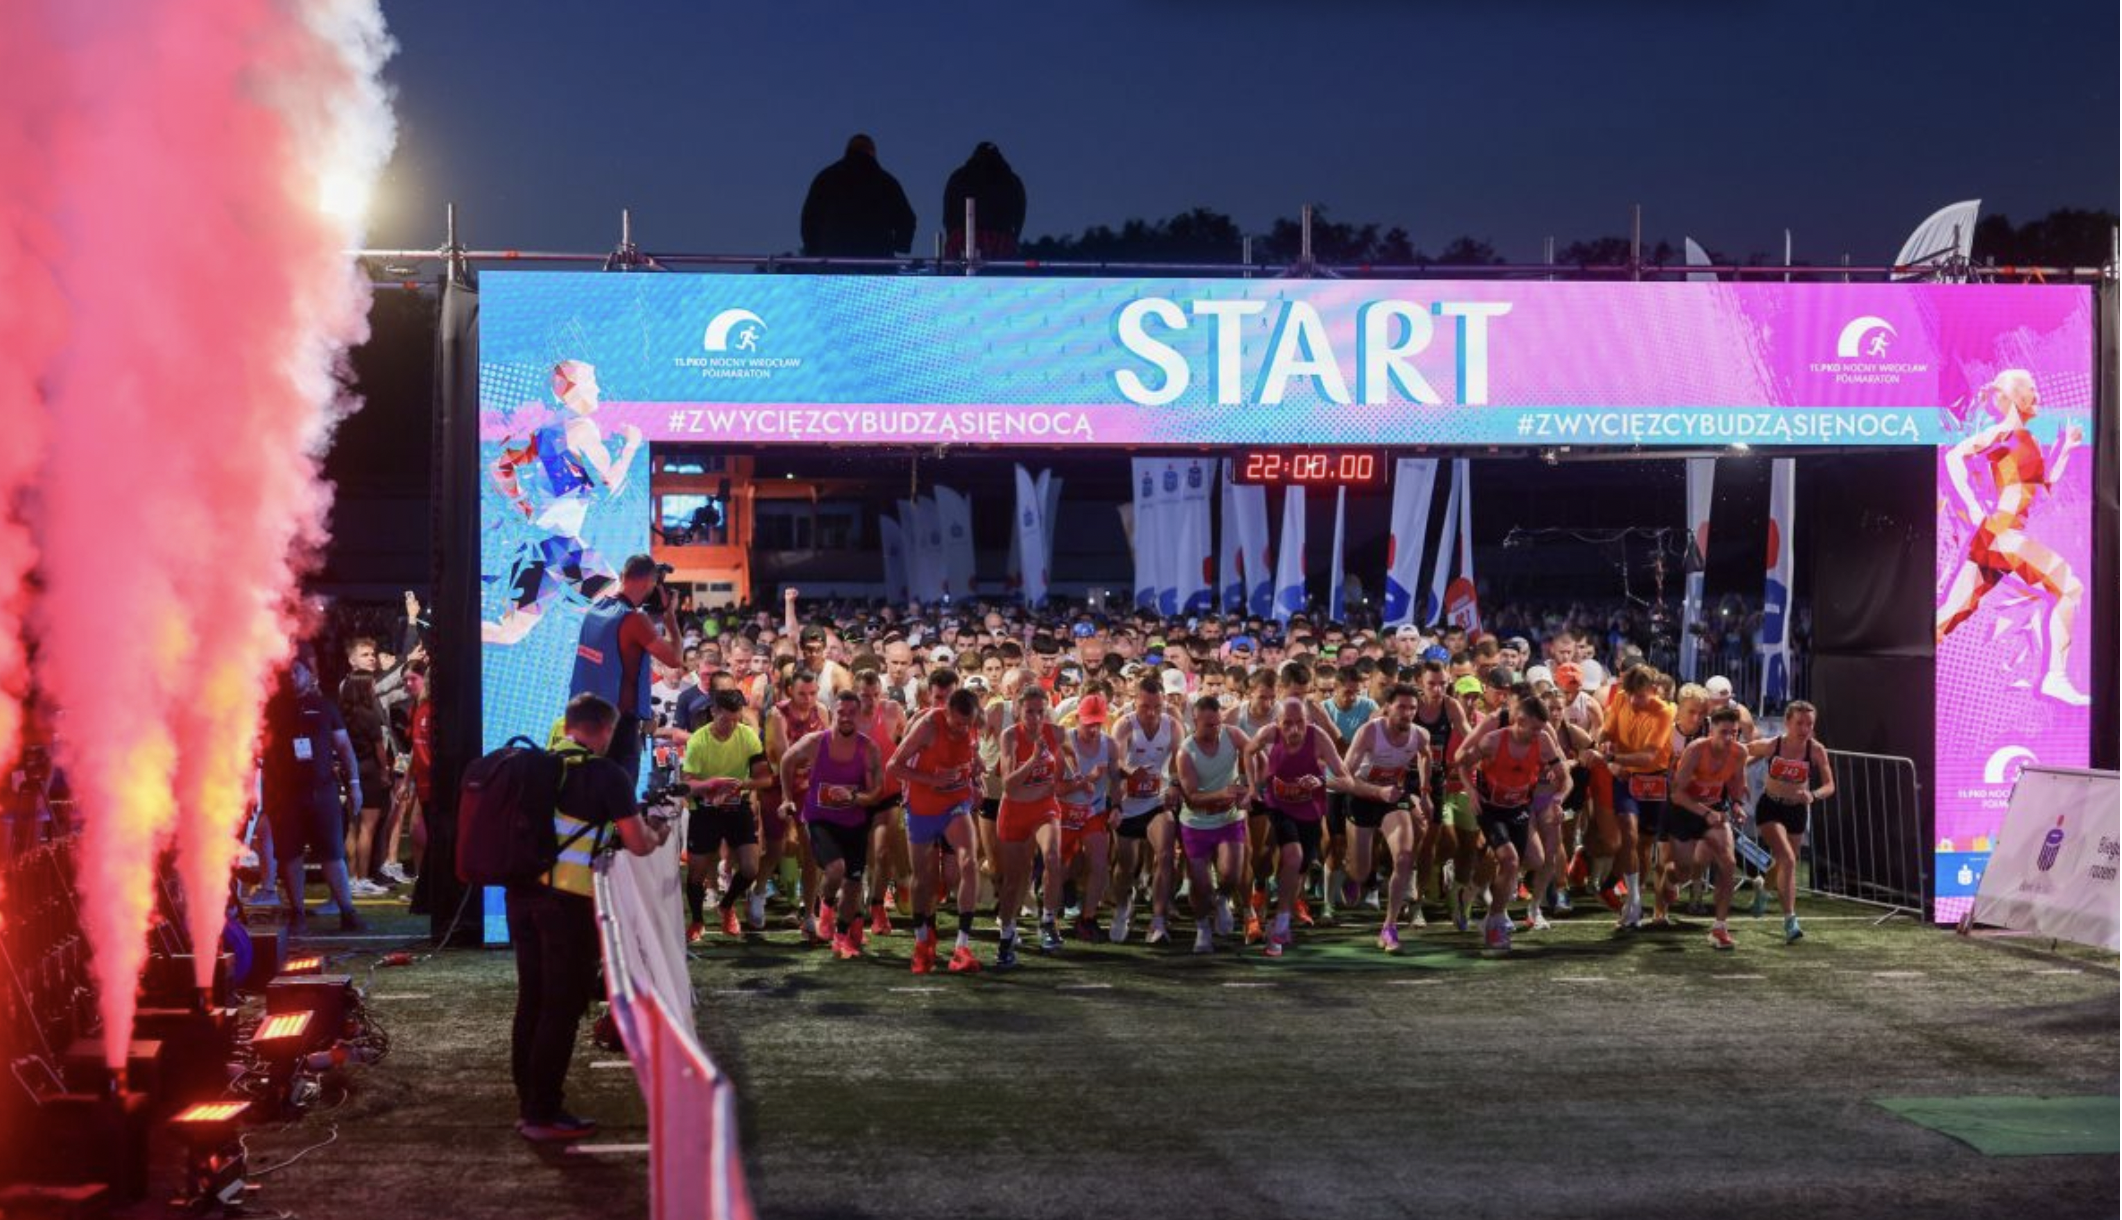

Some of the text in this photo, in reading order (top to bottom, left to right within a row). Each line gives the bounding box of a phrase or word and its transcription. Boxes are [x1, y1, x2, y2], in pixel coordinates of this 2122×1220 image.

[1113, 297, 1512, 405] START
[709, 358, 746, 367] NOCNY
[749, 358, 801, 368] WROCŁAW
[1843, 364, 1876, 372] NOCNY
[1879, 364, 1928, 373] WROCŁAW
[702, 367, 770, 378] PÓŁMARATON
[1836, 373, 1900, 383] PÓŁMARATON
[668, 409, 1094, 439] #ZWYCIĘZCYBUDZĄSIĘNOCĄ
[1517, 413, 1919, 441] #ZWYCIĘZCYBUDZĄSIĘNOCĄ
[1247, 454, 1374, 480] 22:00.00
[1988, 789, 2011, 798] NOC
